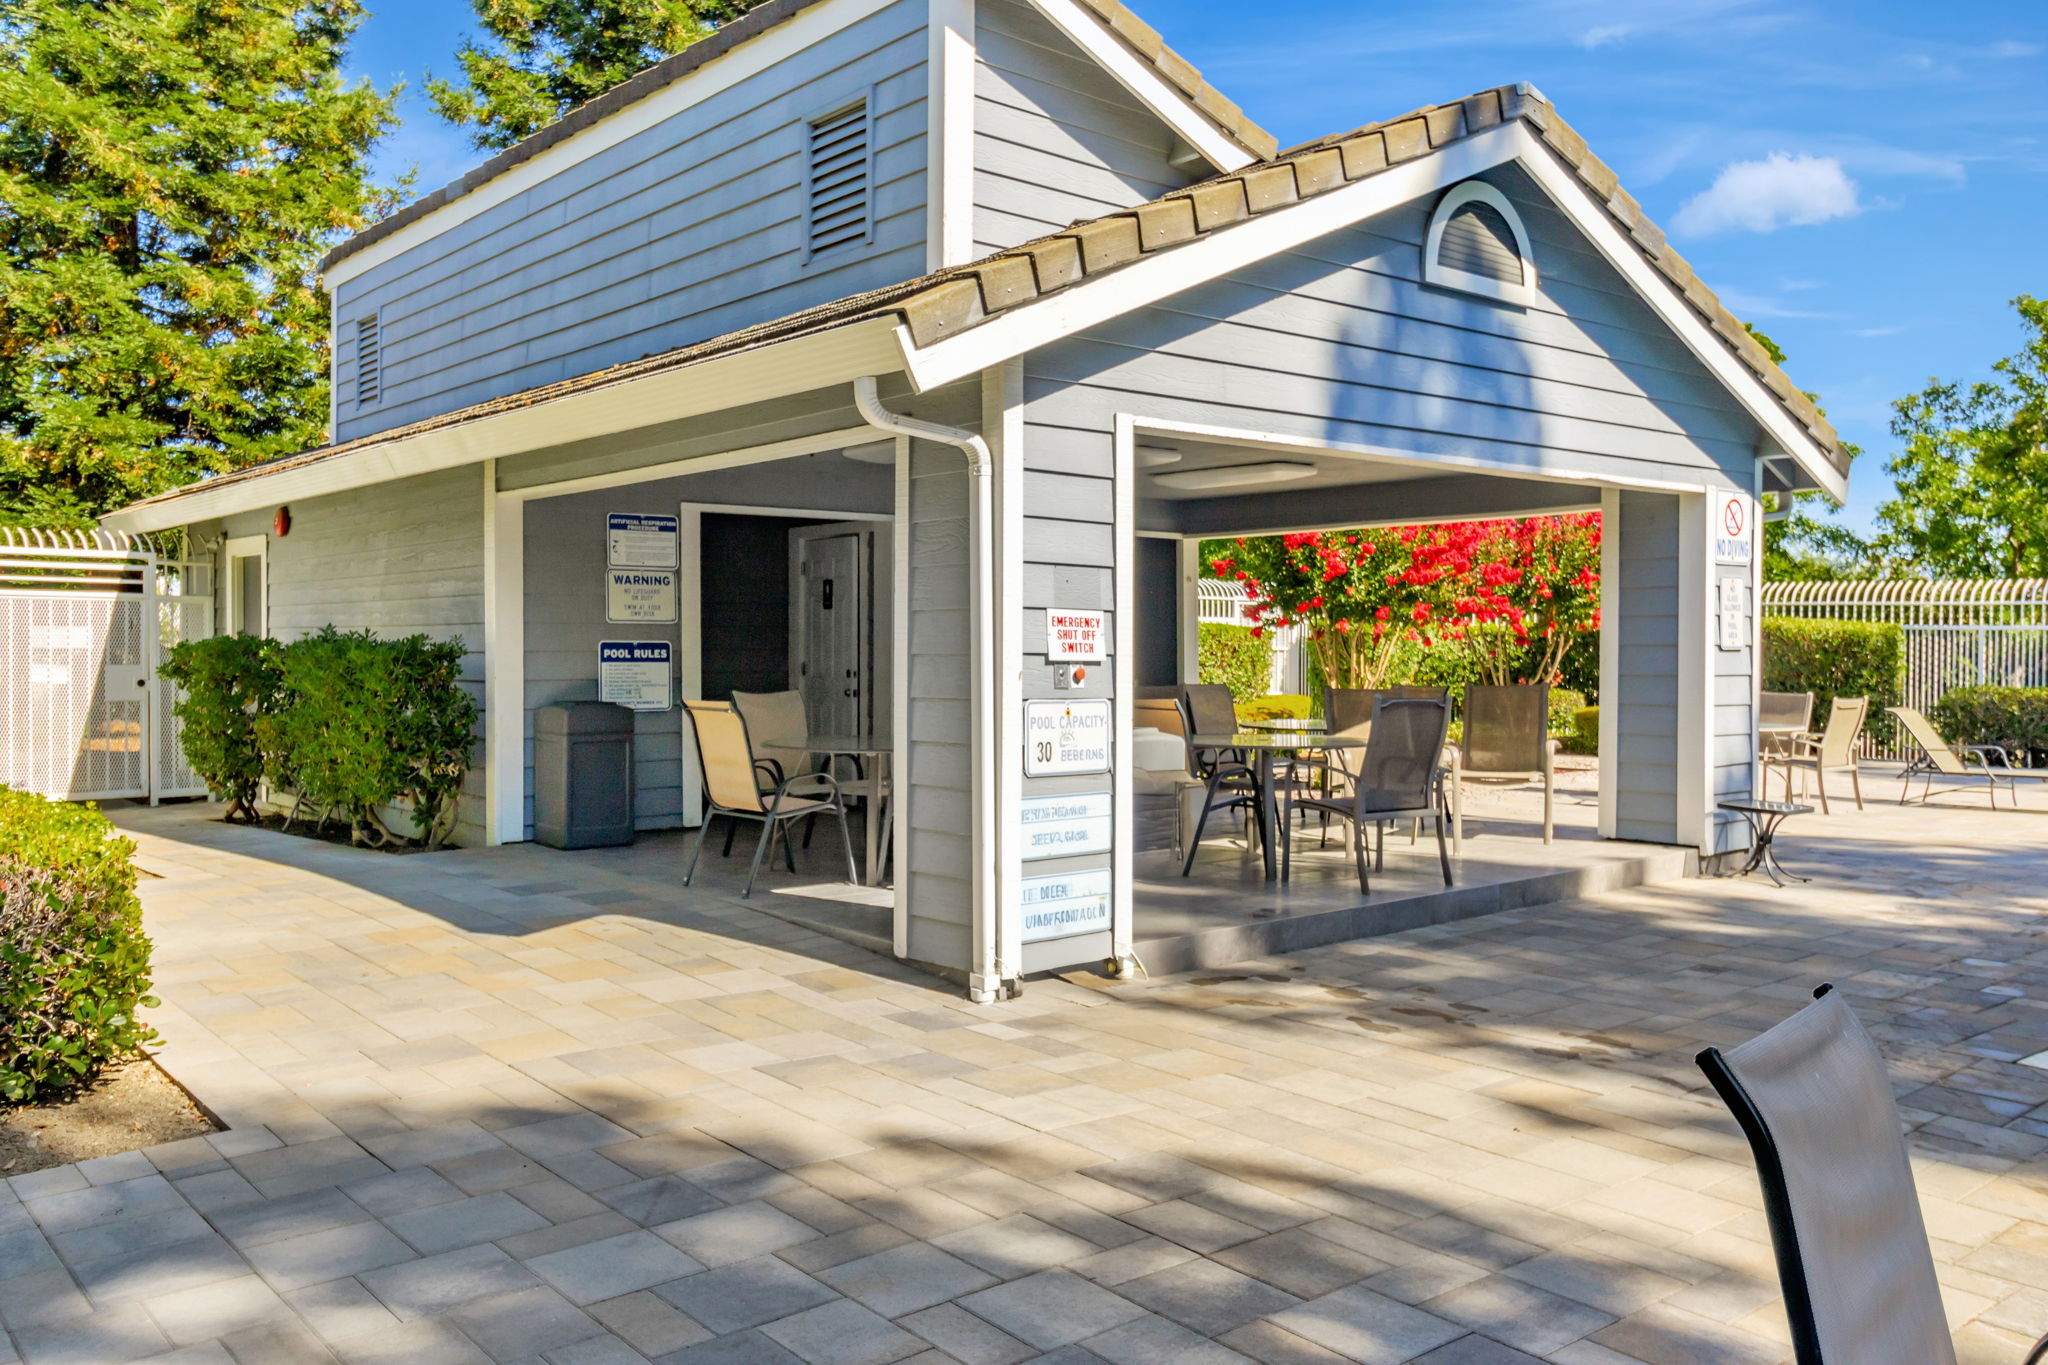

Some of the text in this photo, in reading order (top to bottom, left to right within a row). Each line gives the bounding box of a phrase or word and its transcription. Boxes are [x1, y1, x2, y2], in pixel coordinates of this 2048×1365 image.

[1717, 539, 1749, 558] NO DIVING
[613, 575, 671, 586] WARNING
[1051, 615, 1101, 629] EMERGENCY
[1057, 629, 1096, 641] SHUT OFF
[603, 649, 667, 658] POOL RULES
[1061, 642, 1094, 653] SWITCH
[1029, 714, 1105, 730] POOL CAPACITY
[1037, 741, 1052, 763] 30
